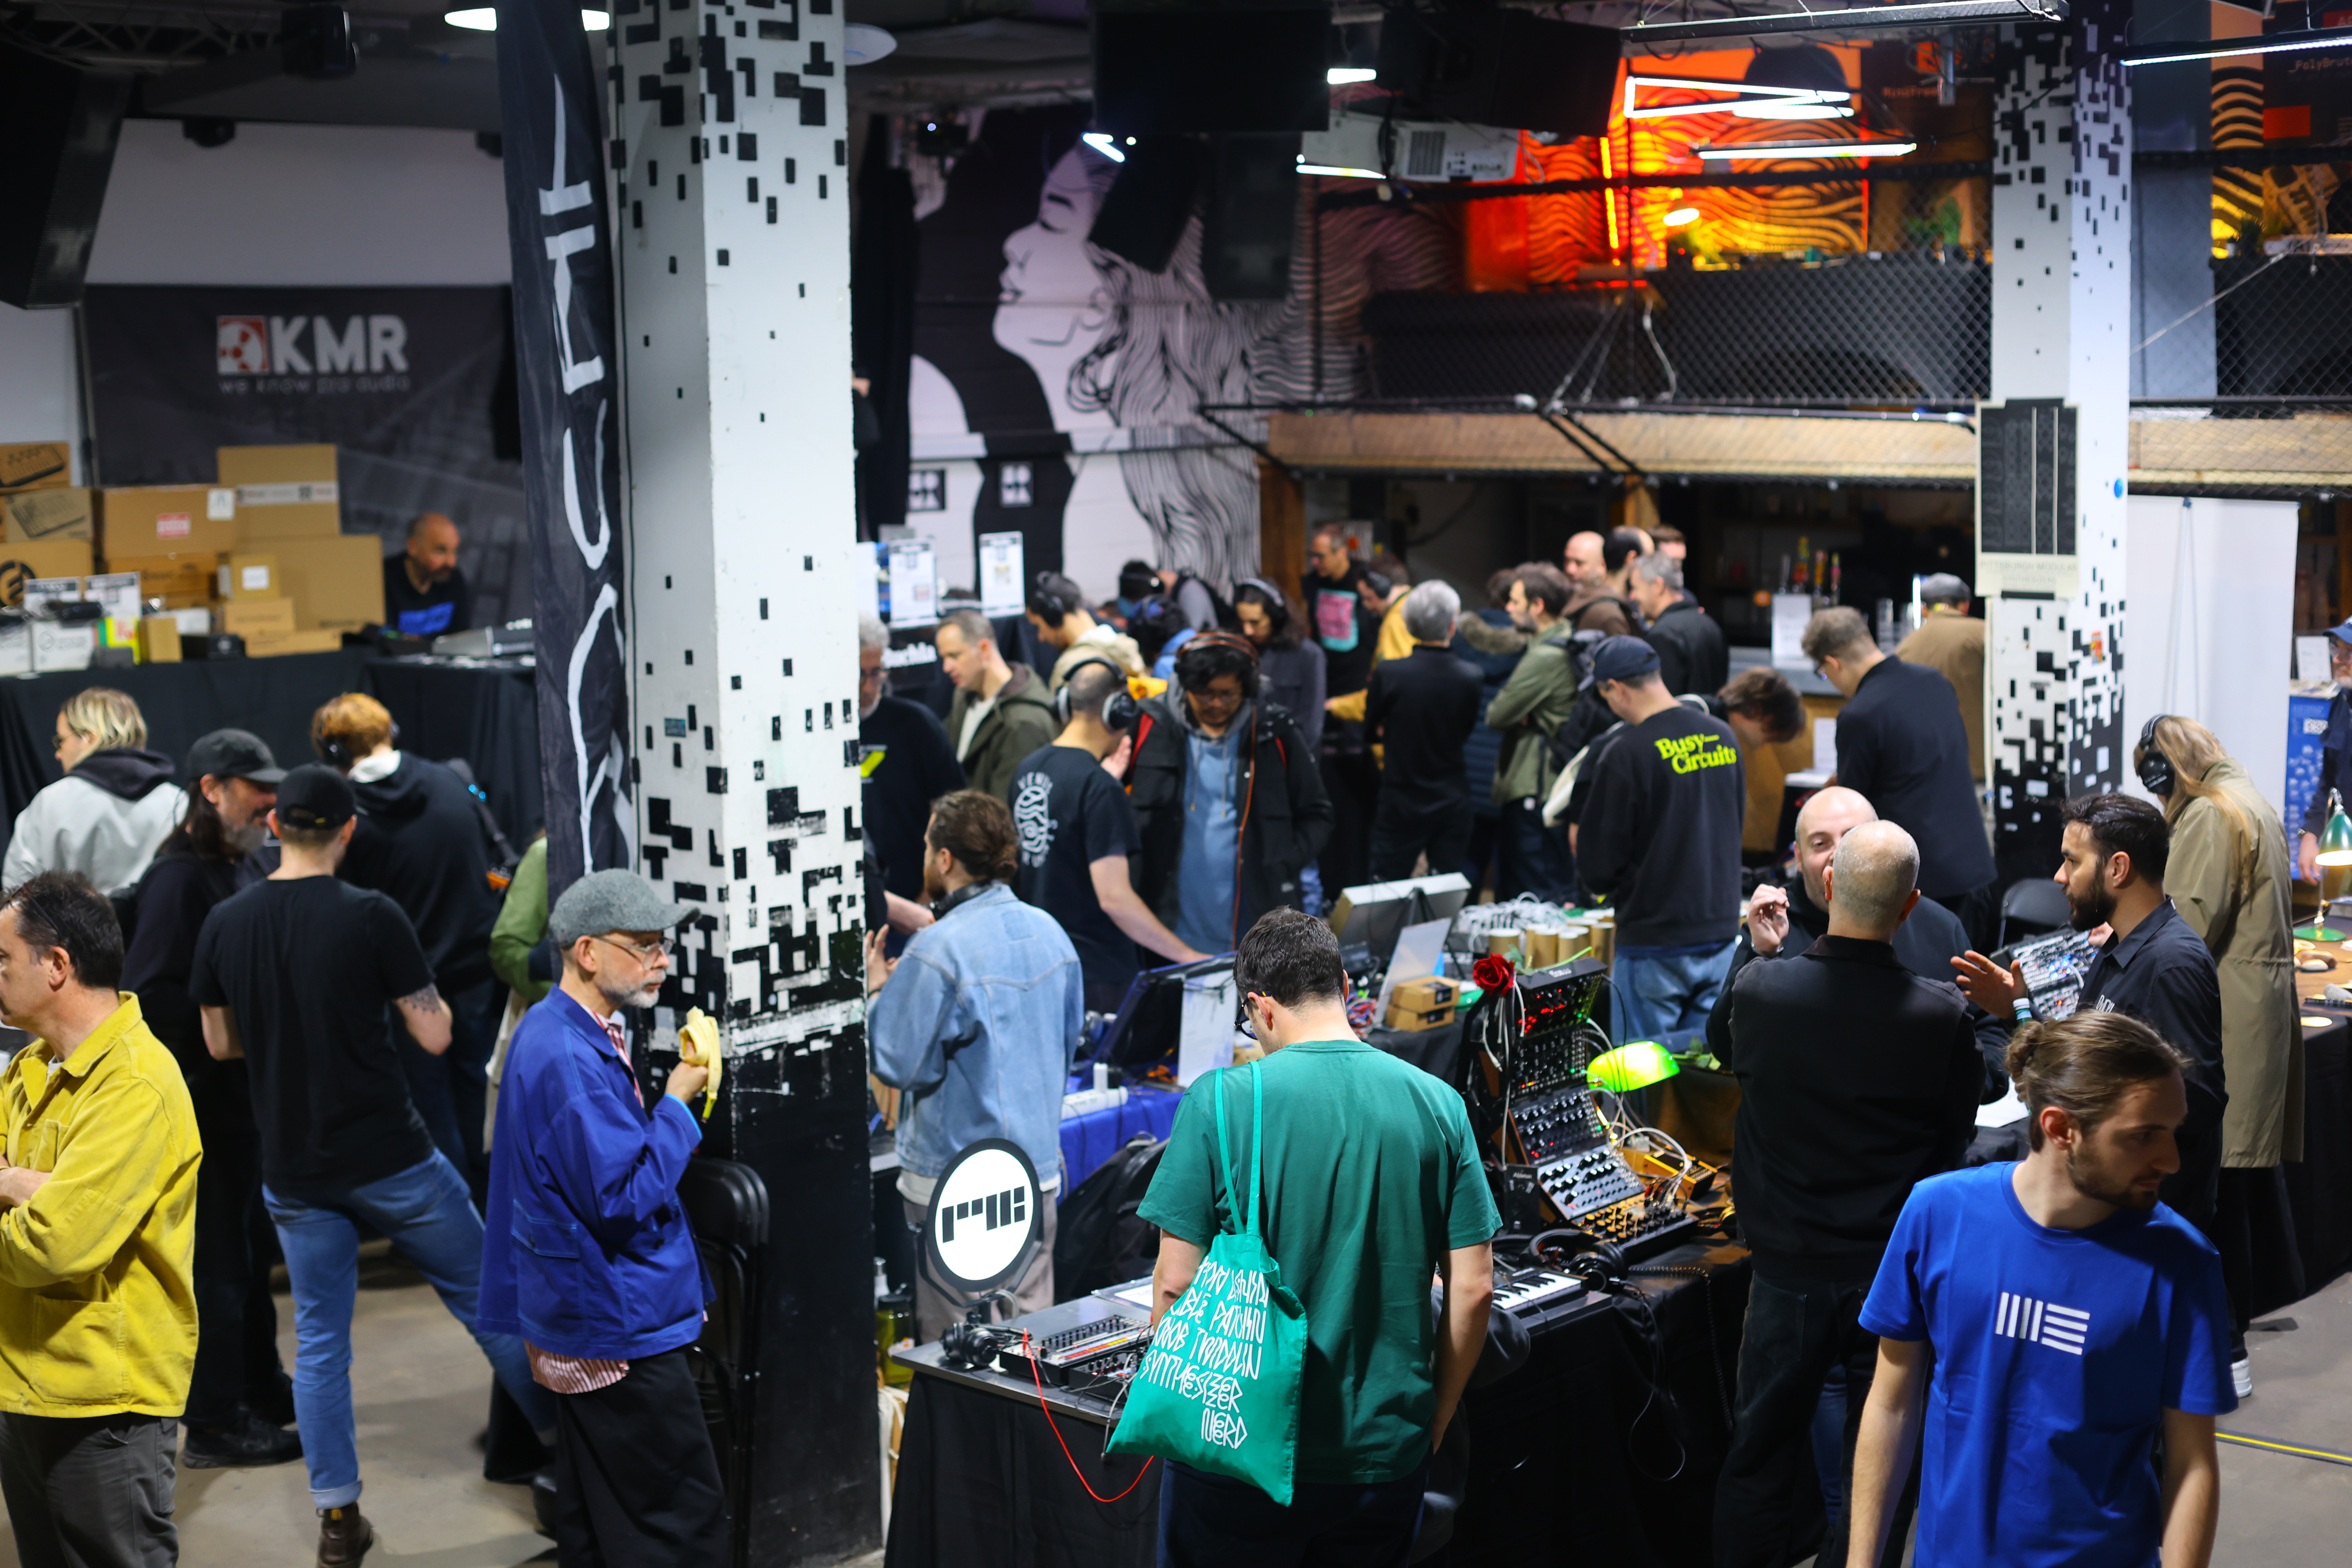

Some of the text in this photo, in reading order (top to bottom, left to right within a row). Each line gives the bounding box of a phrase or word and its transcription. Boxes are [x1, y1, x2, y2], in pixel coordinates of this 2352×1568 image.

[270, 315, 409, 374] KMR
[2037, 562, 2078, 571] MODULAR
[1671, 744, 1737, 774] Circuits
[1140, 1349, 1243, 1413] SYNTHESIZER
[1201, 1407, 1248, 1449] NERD
